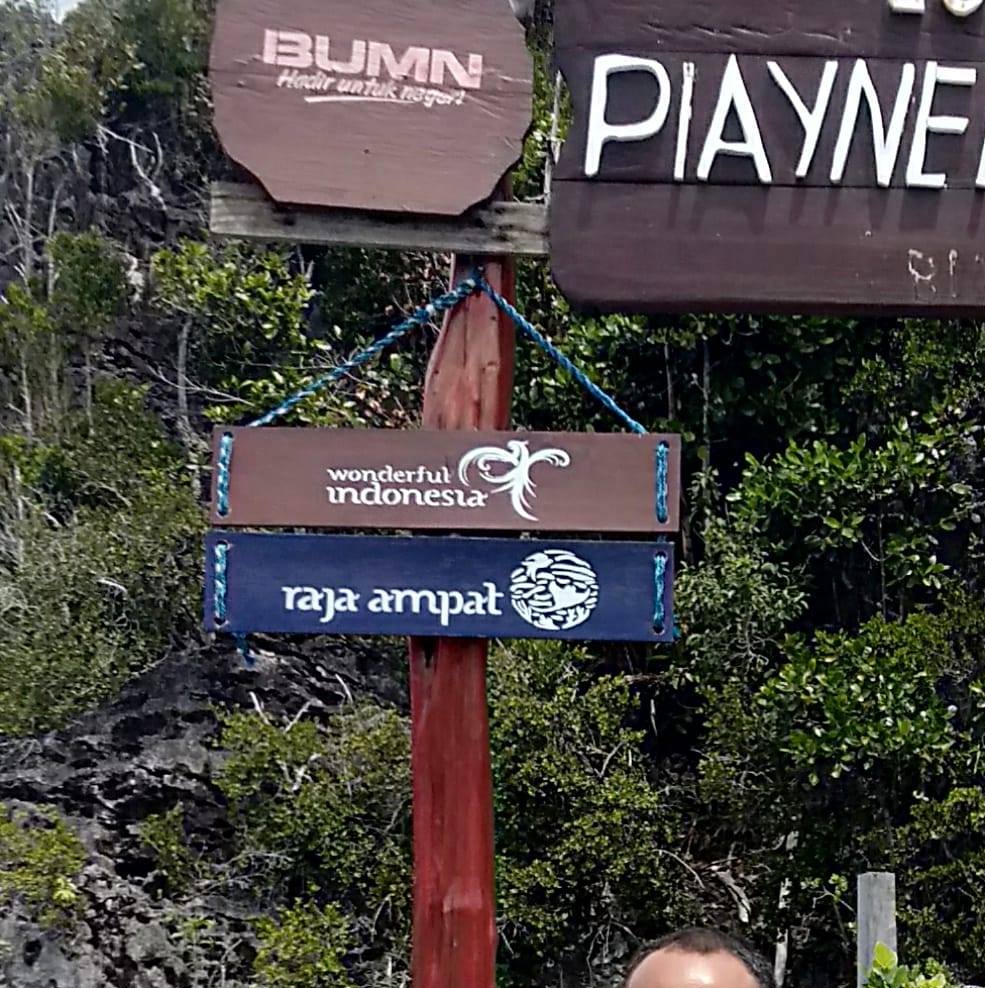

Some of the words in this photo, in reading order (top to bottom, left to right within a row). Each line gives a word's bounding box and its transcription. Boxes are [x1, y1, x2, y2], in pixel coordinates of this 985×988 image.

[263, 29, 483, 89] BUMN
[276, 68, 336, 90] Hadir
[336, 77, 397, 99] untuk
[326, 464, 451, 484] wonderful
[326, 482, 489, 507] indonesia
[281, 586, 361, 624] raja
[367, 582, 505, 627] ampat
